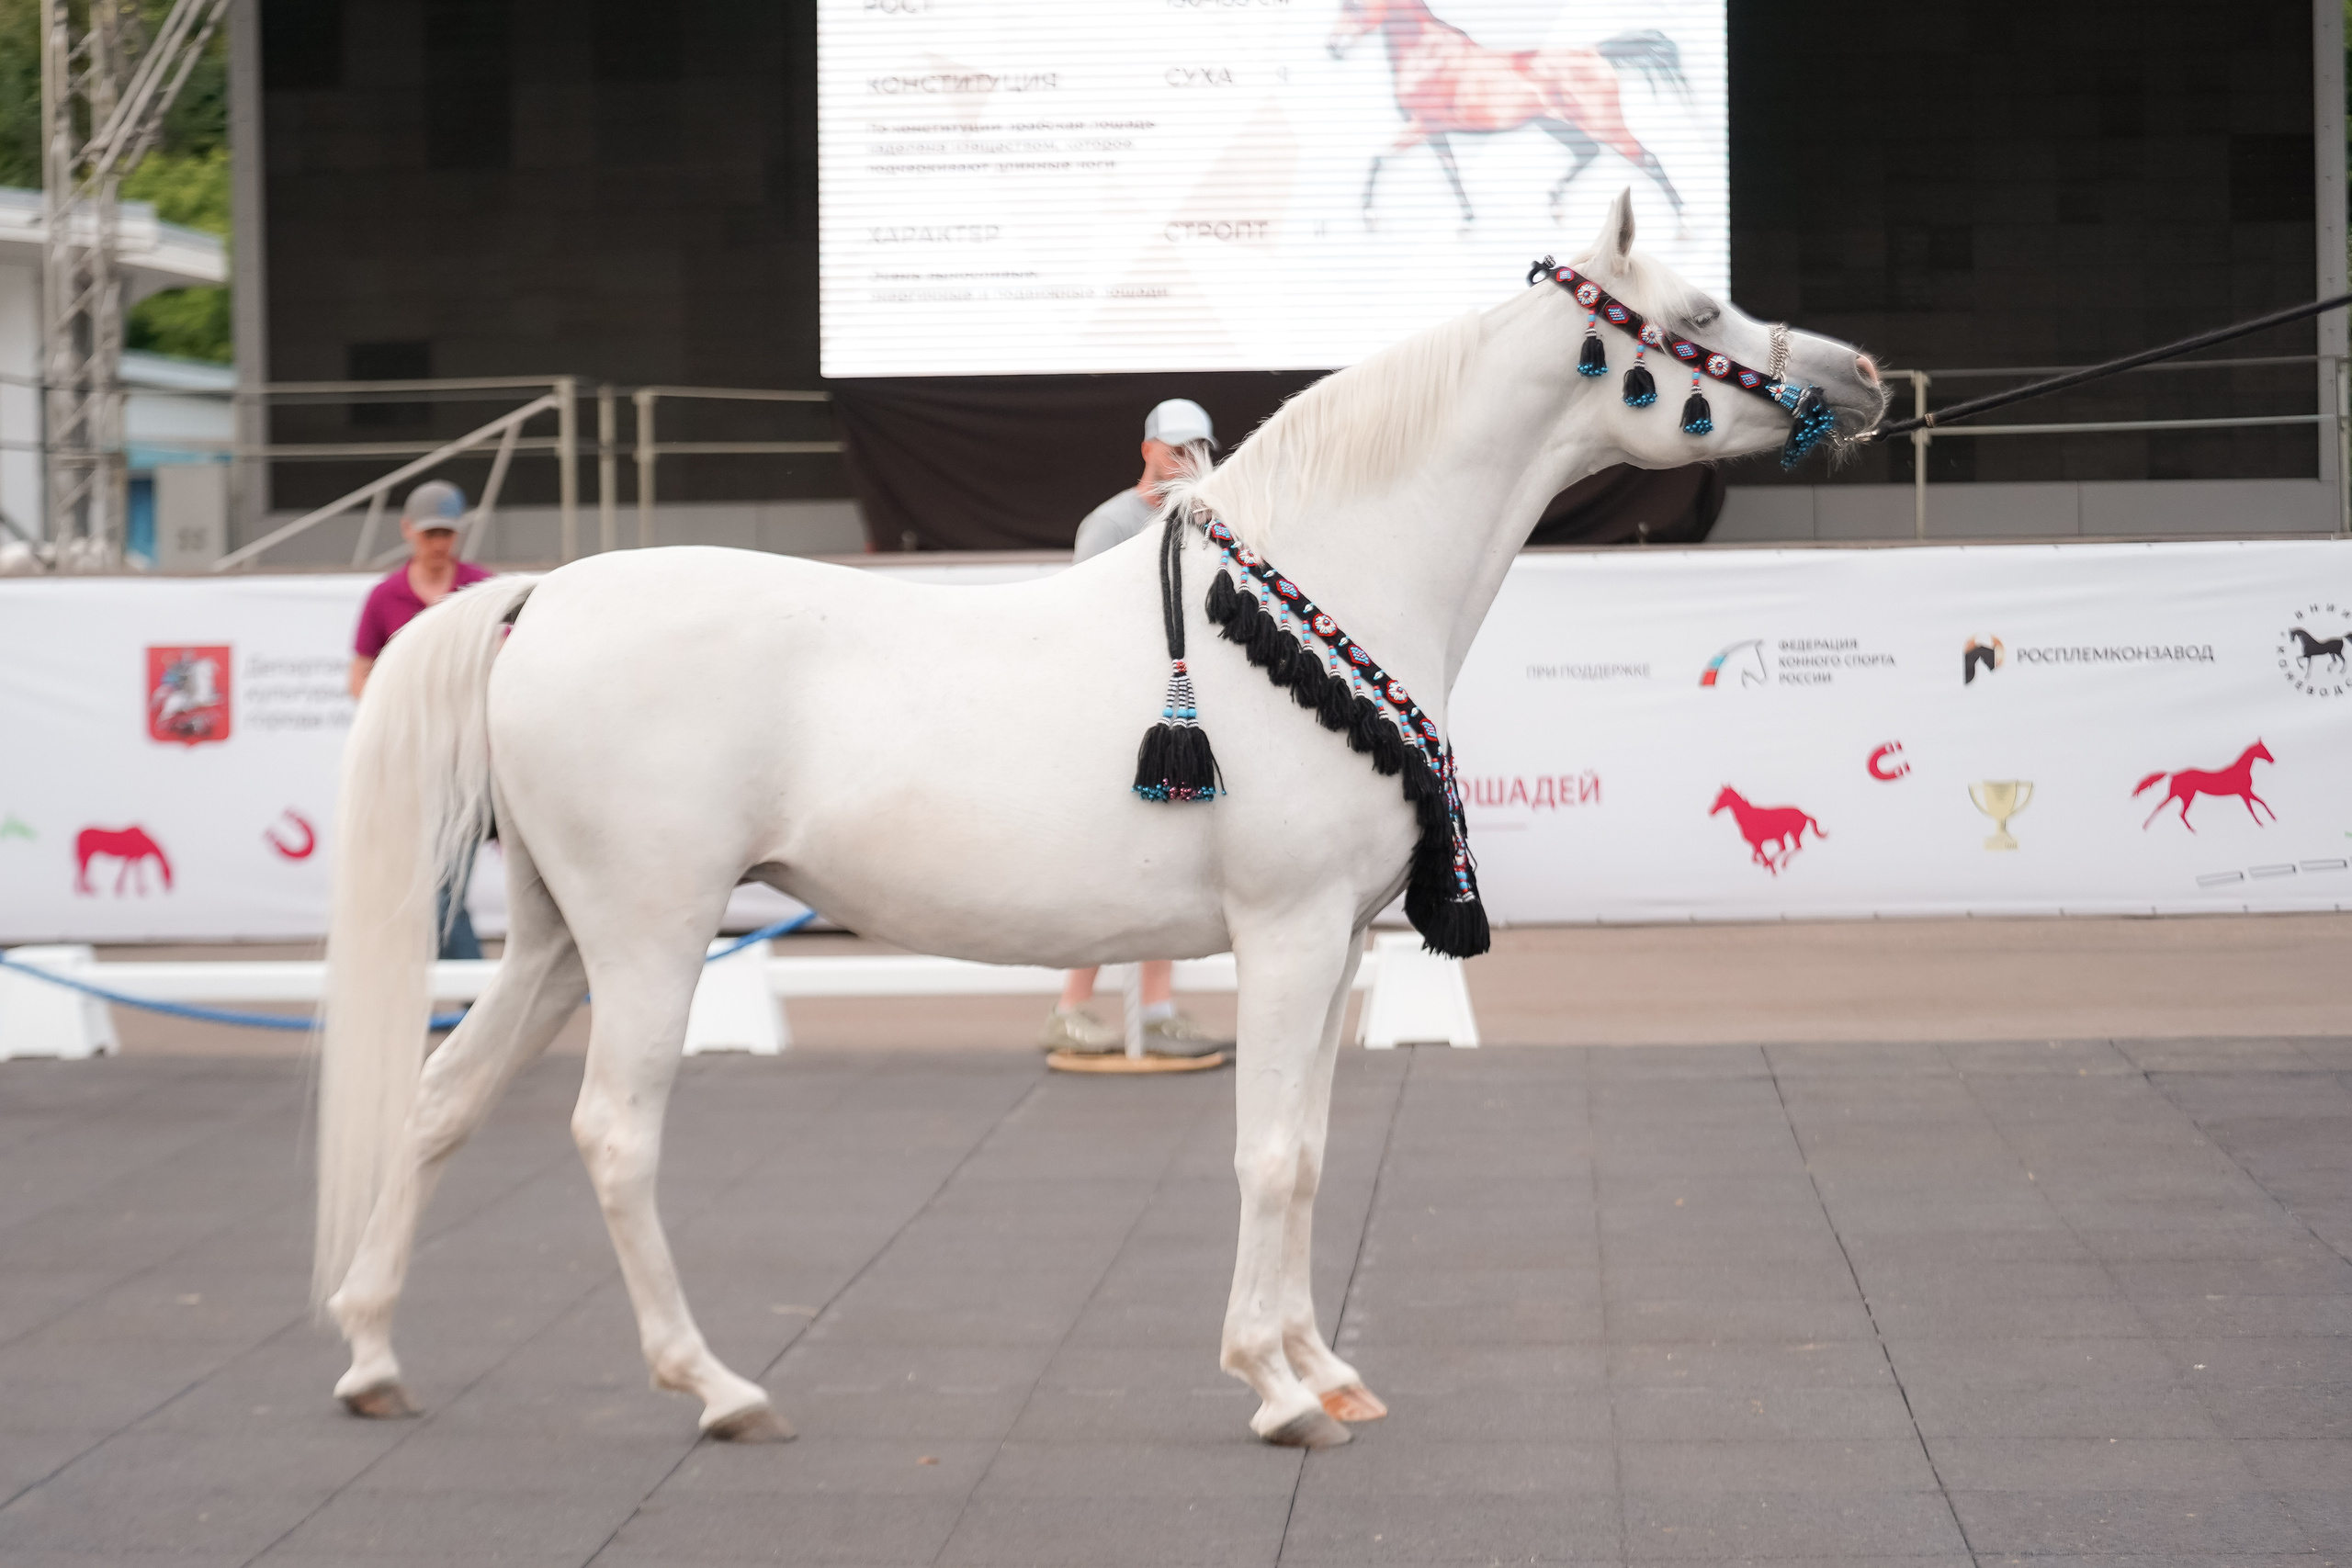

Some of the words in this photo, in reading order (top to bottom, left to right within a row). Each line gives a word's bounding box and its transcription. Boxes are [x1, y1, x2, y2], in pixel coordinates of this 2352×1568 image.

[866, 72, 1060, 94] КОНСТИТУЦИЯ
[1778, 637, 1859, 652] ФЕДЕРАЦИЯ
[1778, 654, 1841, 670] КОННОГО
[1844, 653, 1897, 669] СПОРТА
[2016, 644, 2215, 665] РОСПЛЕМКОНЗАВОД
[1525, 663, 1556, 680] ПРИ
[1559, 662, 1651, 681] ПОДДЕРЖКЕ
[1778, 671, 1833, 686] РОССИИ
